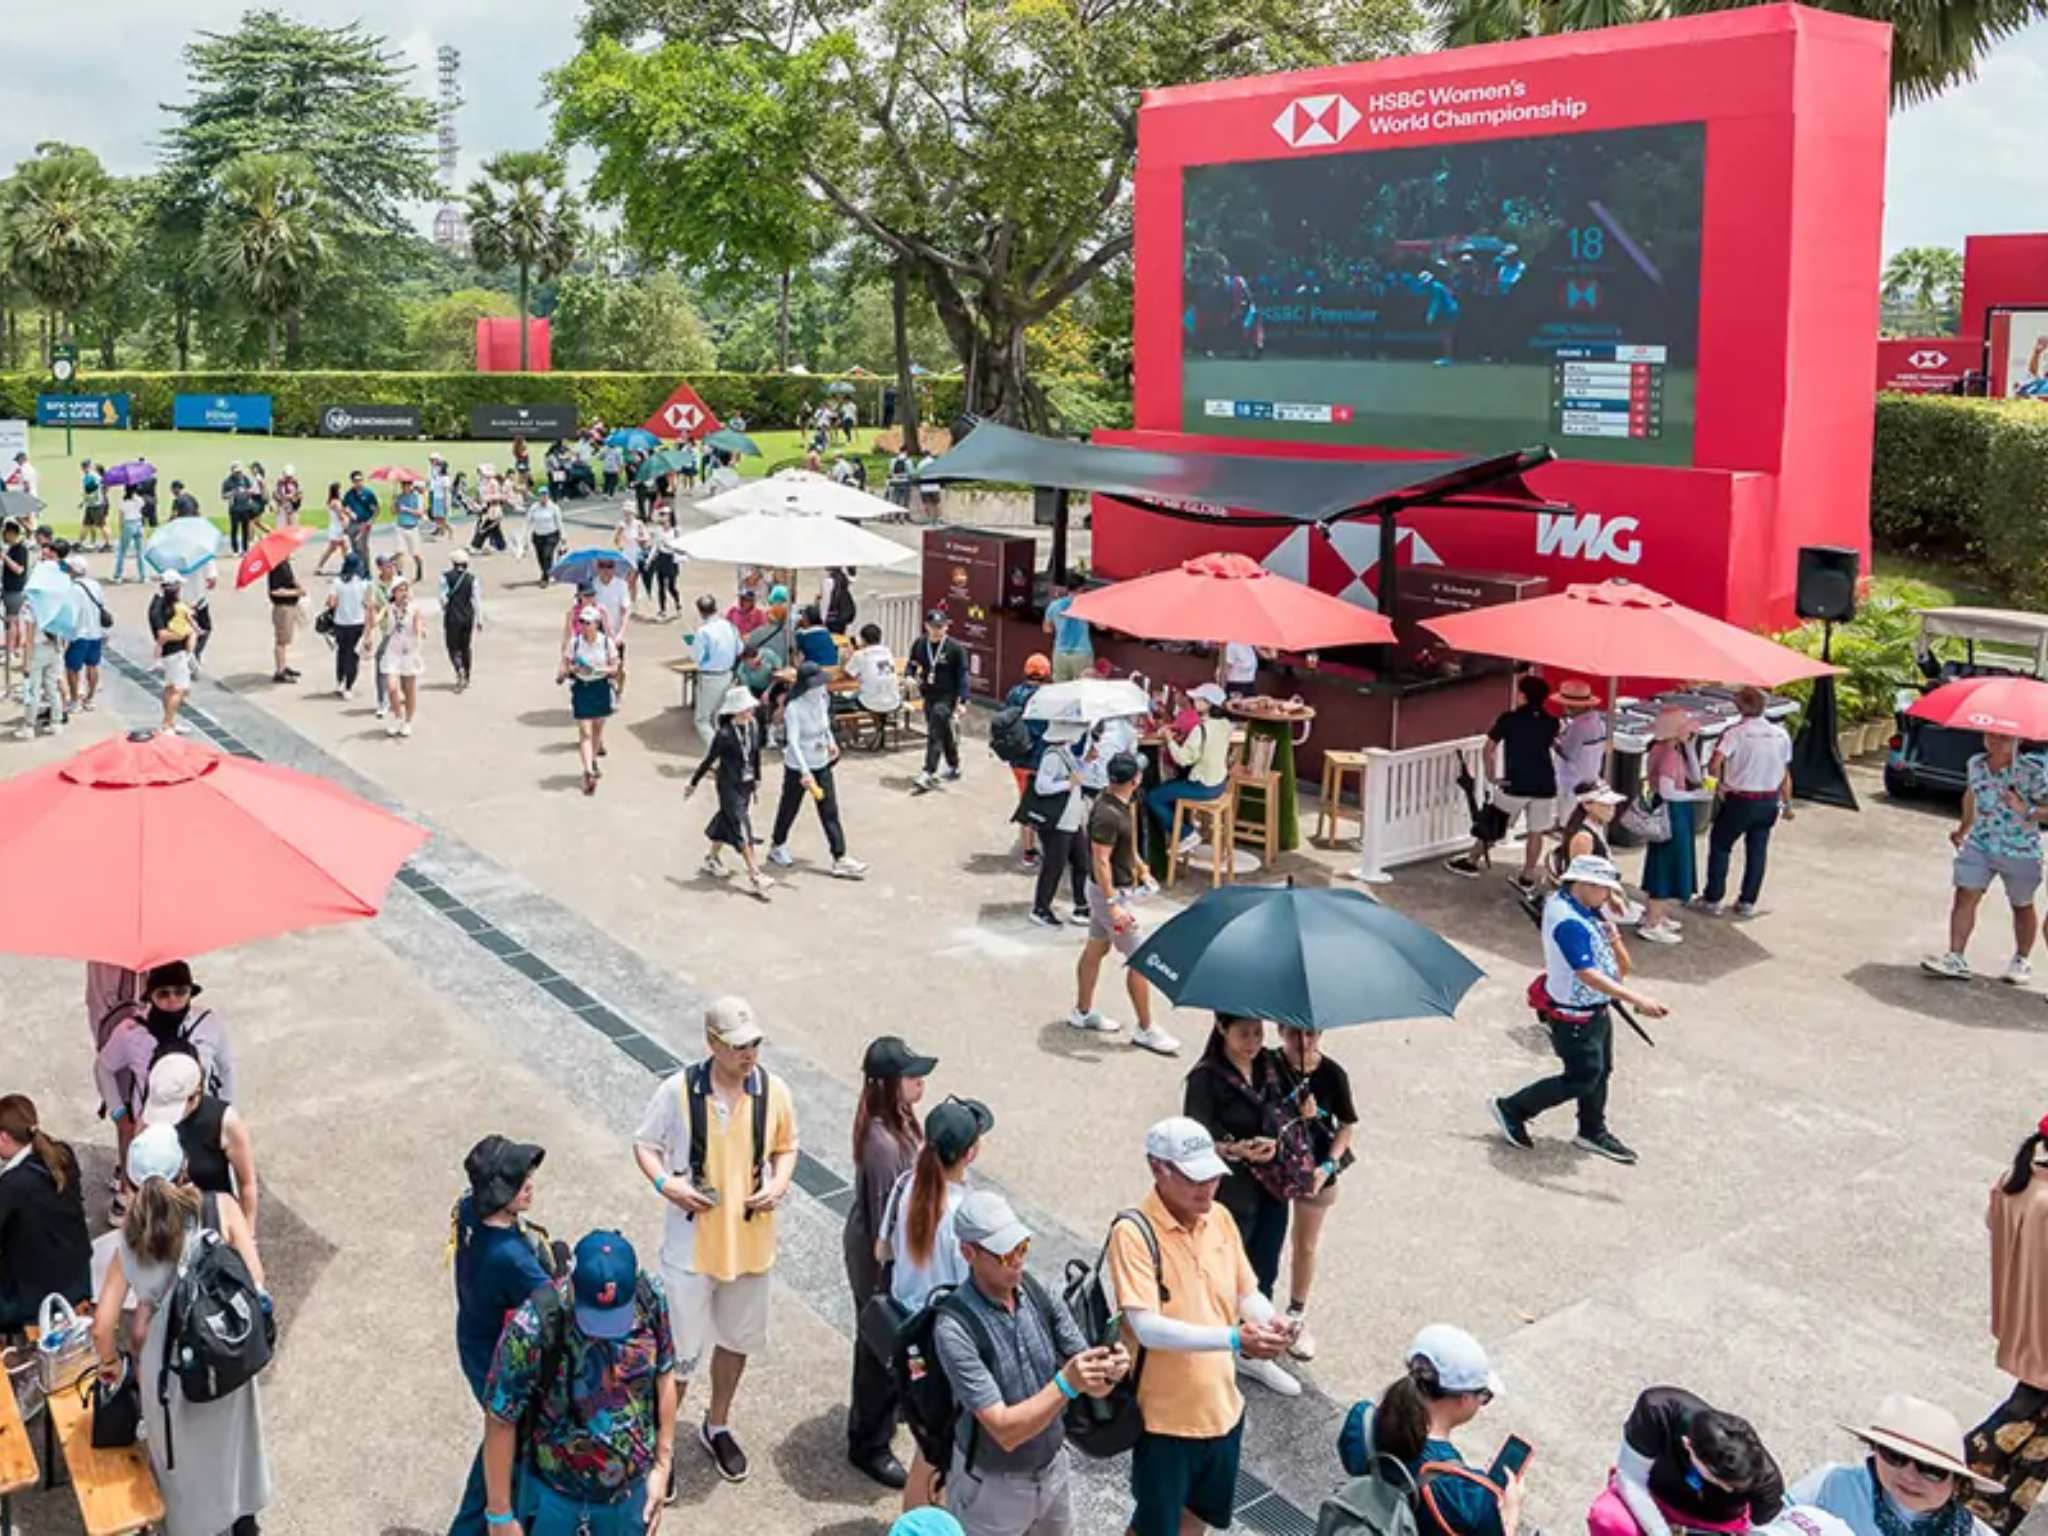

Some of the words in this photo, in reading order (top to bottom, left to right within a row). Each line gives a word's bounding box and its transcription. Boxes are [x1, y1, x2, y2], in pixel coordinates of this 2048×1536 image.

[1369, 88, 1425, 112] HSBC
[1427, 79, 1526, 105] Women's
[1369, 110, 1430, 134] World
[1432, 97, 1587, 128] Championship
[1566, 226, 1603, 261] 18
